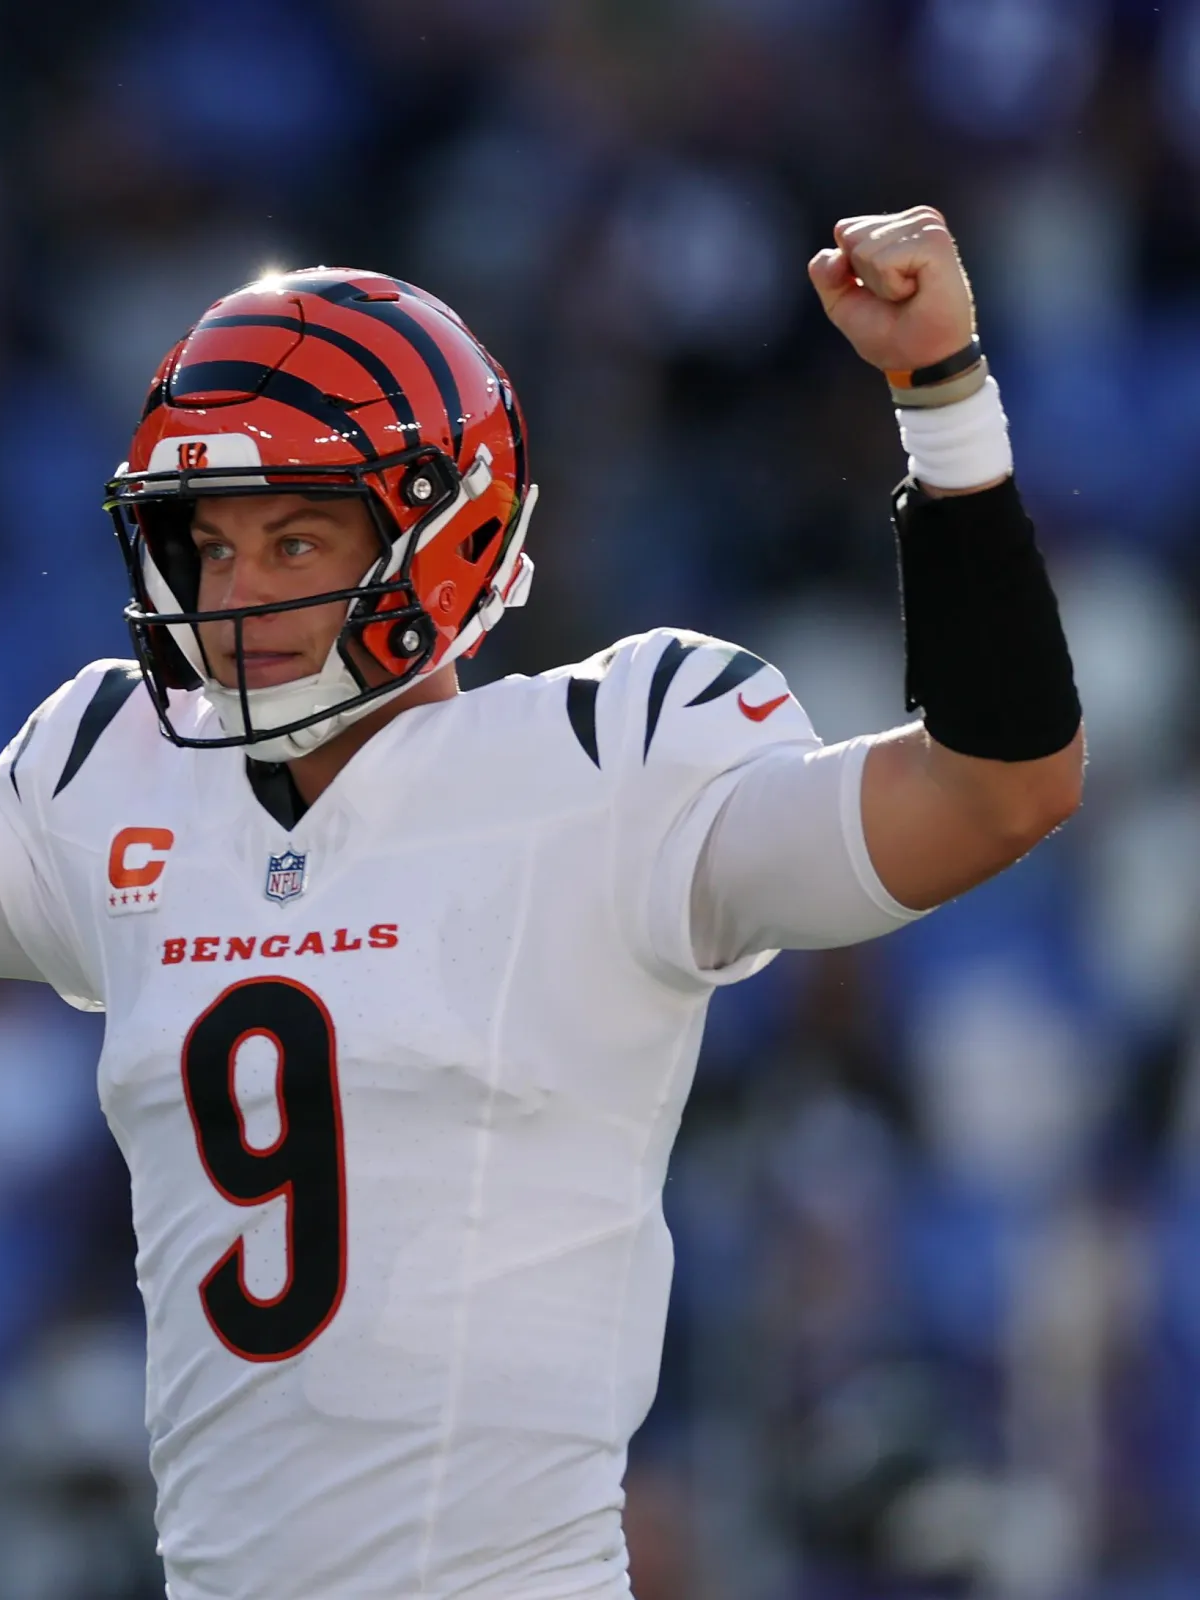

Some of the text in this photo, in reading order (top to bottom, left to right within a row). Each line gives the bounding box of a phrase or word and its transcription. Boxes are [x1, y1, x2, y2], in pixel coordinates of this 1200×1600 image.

[108, 827, 174, 889] C
[270, 872, 300, 894] NFL
[161, 924, 398, 965] BENGALS
[181, 975, 347, 1361] 9
